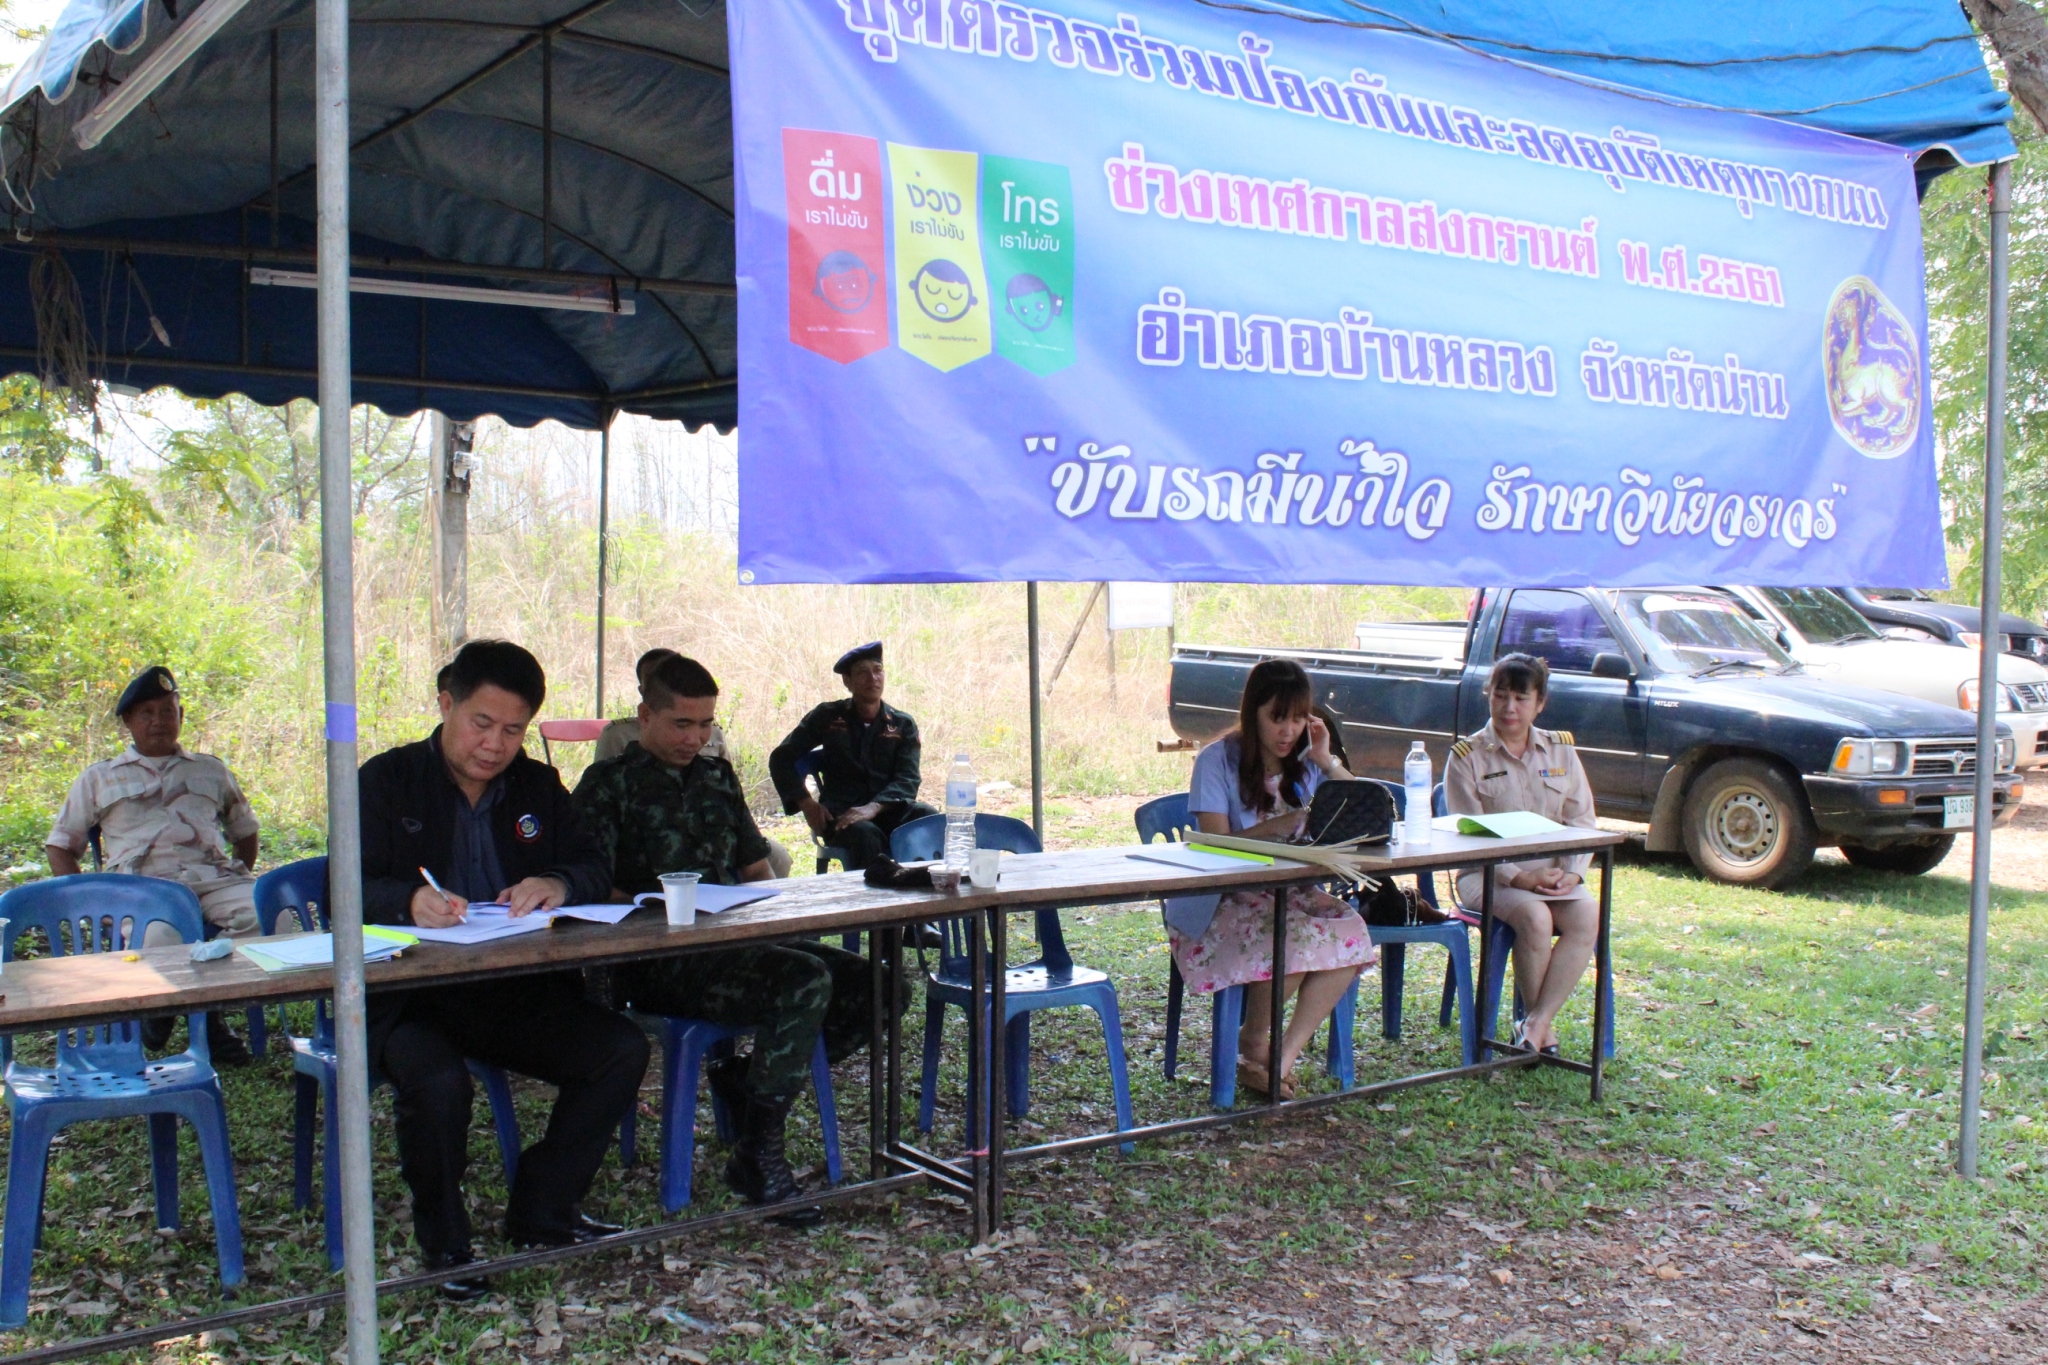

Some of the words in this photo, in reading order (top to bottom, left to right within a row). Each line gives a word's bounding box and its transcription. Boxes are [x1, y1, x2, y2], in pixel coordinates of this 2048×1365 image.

[808, 149, 862, 201] ดื่ม
[906, 171, 962, 215] ง่วง
[805, 204, 868, 229] เราไม่ขับ
[1001, 182, 1060, 226] โทร
[1104, 142, 1599, 278] ช่วงเทศกาลสงกรานต์
[1618, 239, 1785, 308] พ.ศ.2561
[910, 217, 965, 241] เราไม่ขับ
[1000, 230, 1060, 252] เราไม่ขับ
[1137, 286, 1557, 397] อำเภอบ้านหลวง
[1580, 337, 1789, 419] จังหวัดน่าน
